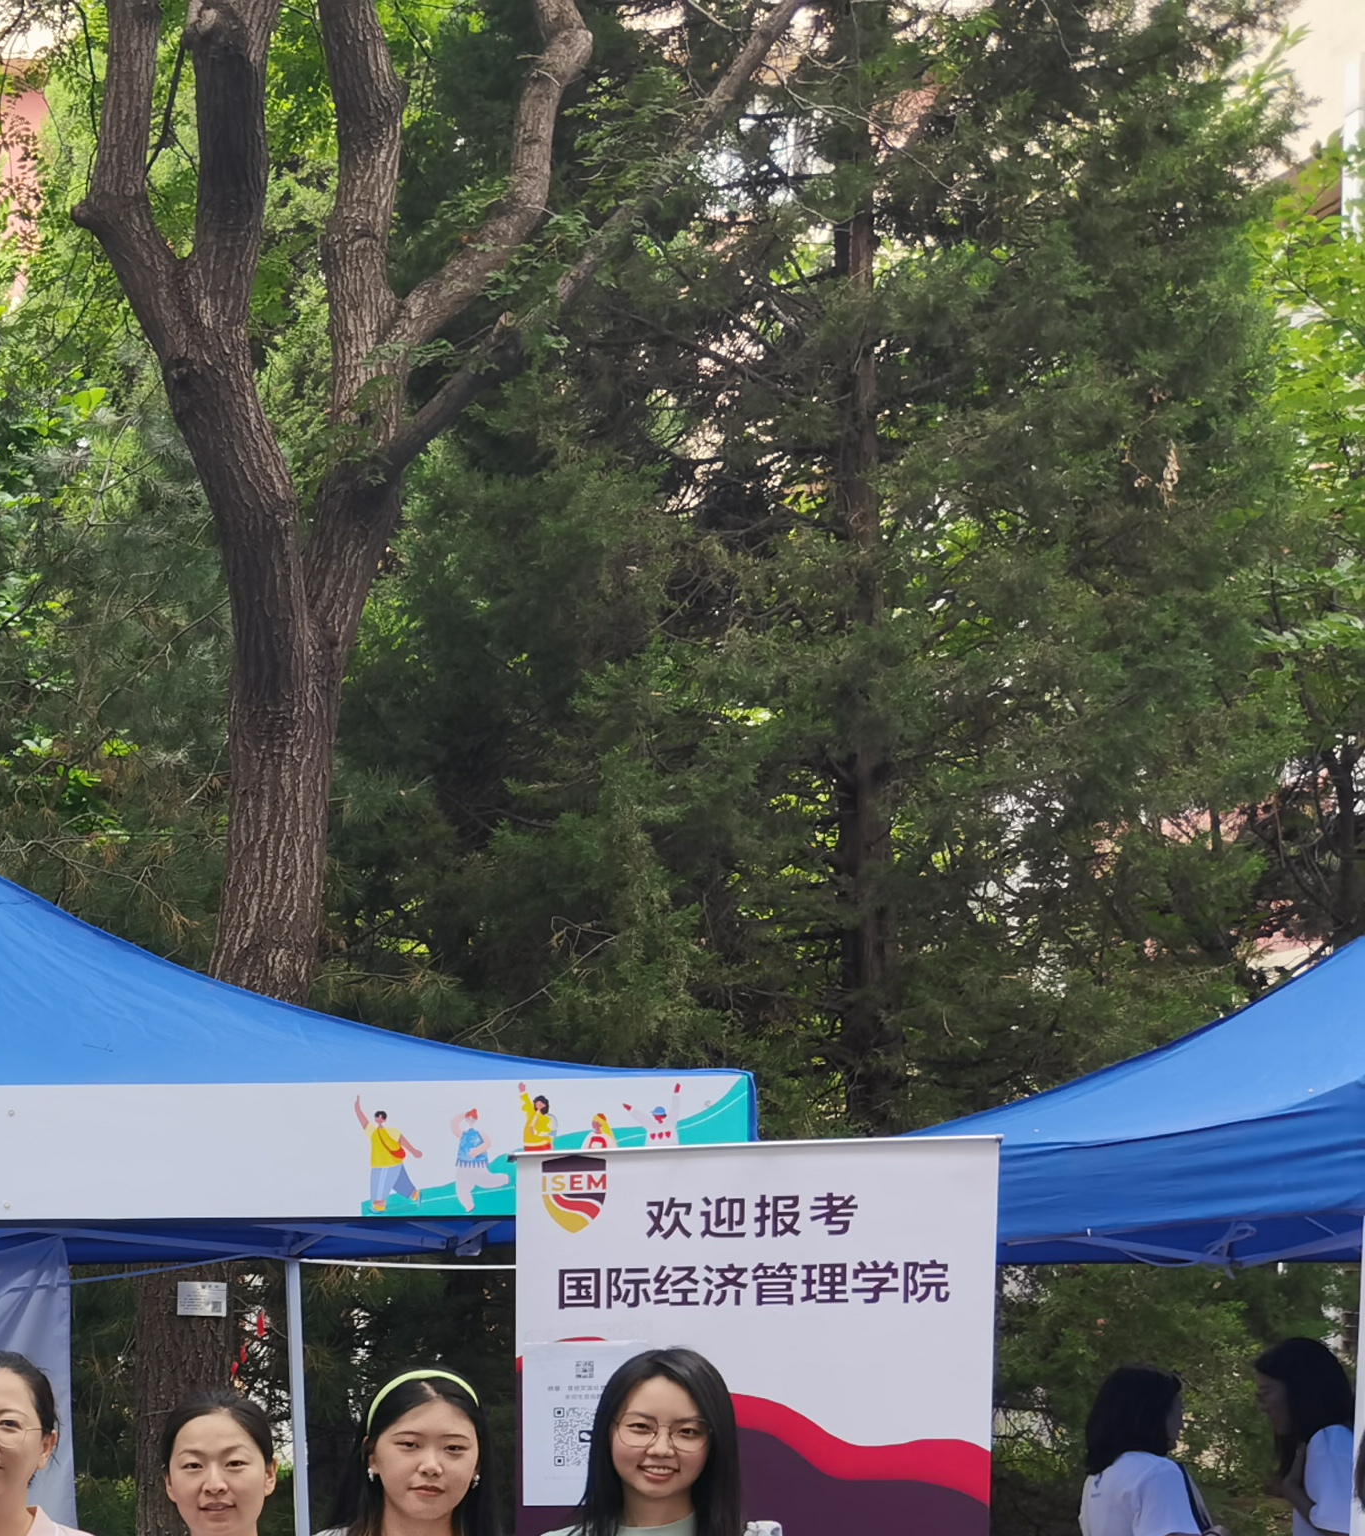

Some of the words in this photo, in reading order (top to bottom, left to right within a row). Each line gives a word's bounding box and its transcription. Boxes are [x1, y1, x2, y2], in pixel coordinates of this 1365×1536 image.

[541, 1174, 607, 1192] ISEM
[645, 1192, 858, 1239] 欢迎报考
[558, 1260, 950, 1309] 国际经济管理学院
